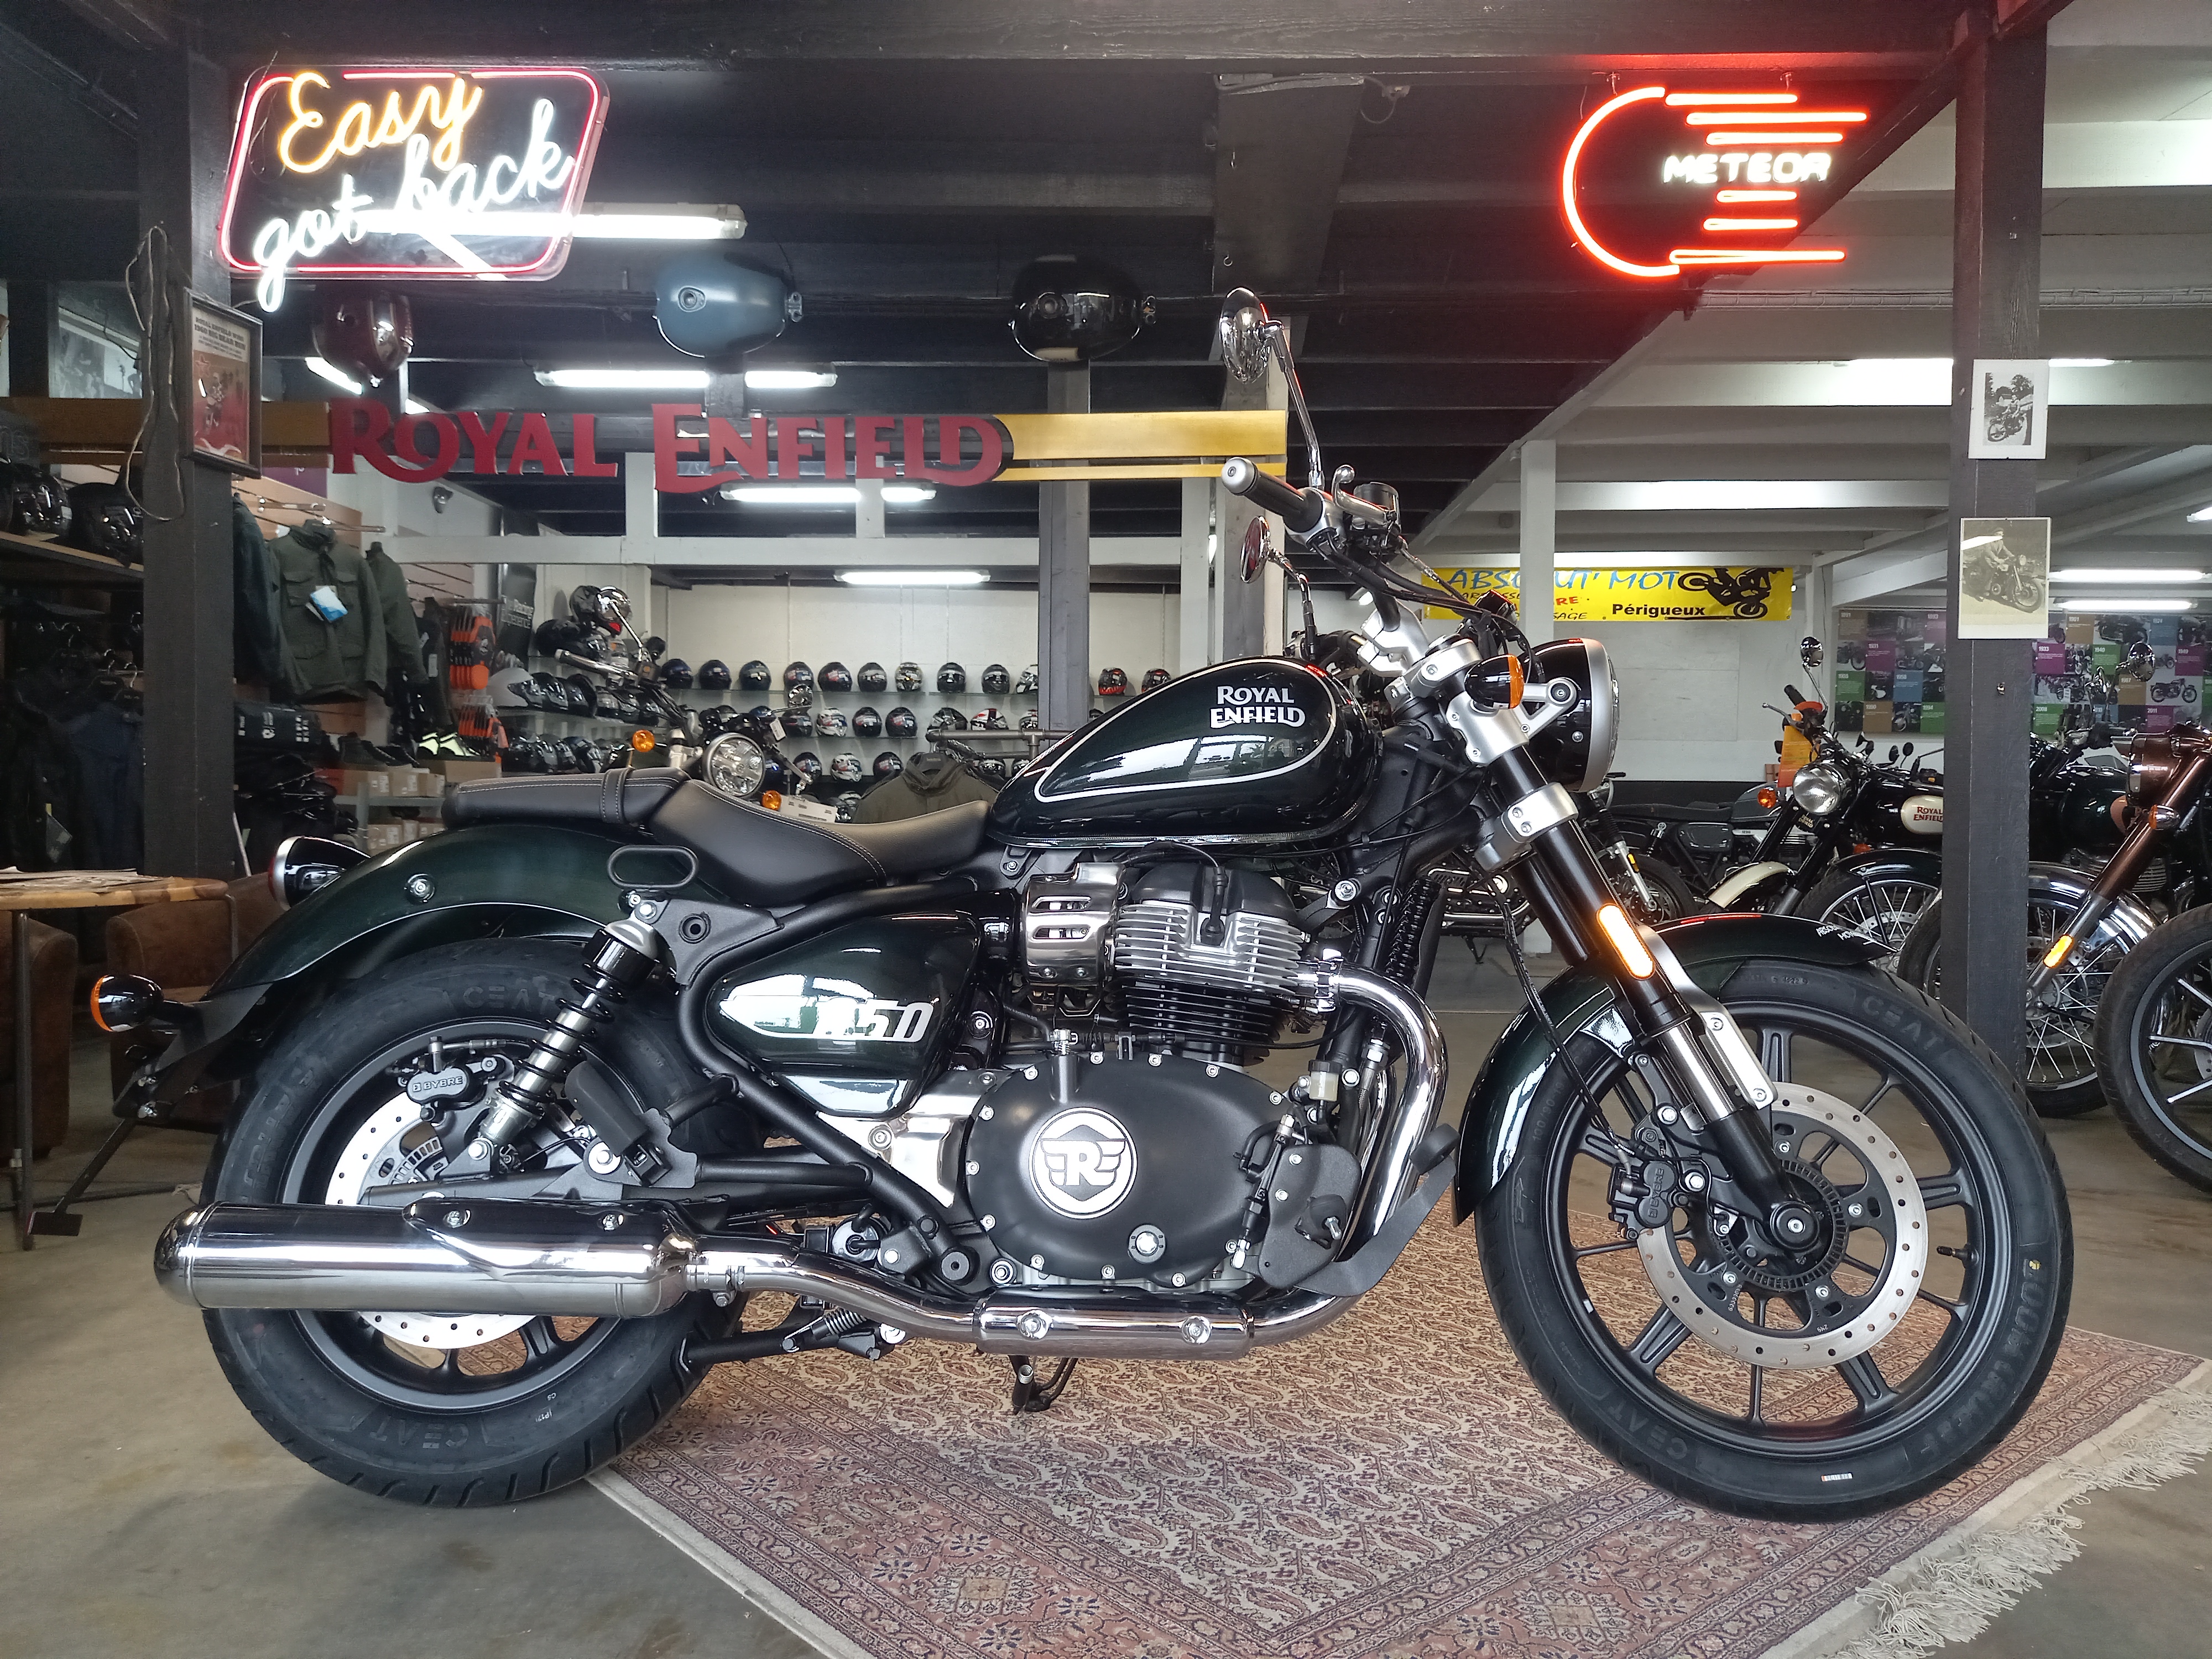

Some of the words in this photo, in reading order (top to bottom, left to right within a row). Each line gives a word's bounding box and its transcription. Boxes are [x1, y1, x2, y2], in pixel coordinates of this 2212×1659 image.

[279, 71, 484, 173] Easy
[1663, 153, 1832, 184] METEOR
[253, 174, 374, 312] got
[392, 98, 574, 214] back
[331, 398, 618, 484] ROYAL
[651, 403, 1014, 494] ENFIELD
[1612, 603, 1705, 618] Périgueux
[1217, 686, 1295, 706] ROYAL
[1210, 706, 1306, 728] ENFIELD
[1917, 806, 1943, 815] ROYAL
[463, 986, 555, 1015] CEAT
[423, 1076, 463, 1091] BYBRE
[1649, 1168, 1665, 1206] BYBRE
[371, 1416, 469, 1449] CEAT
